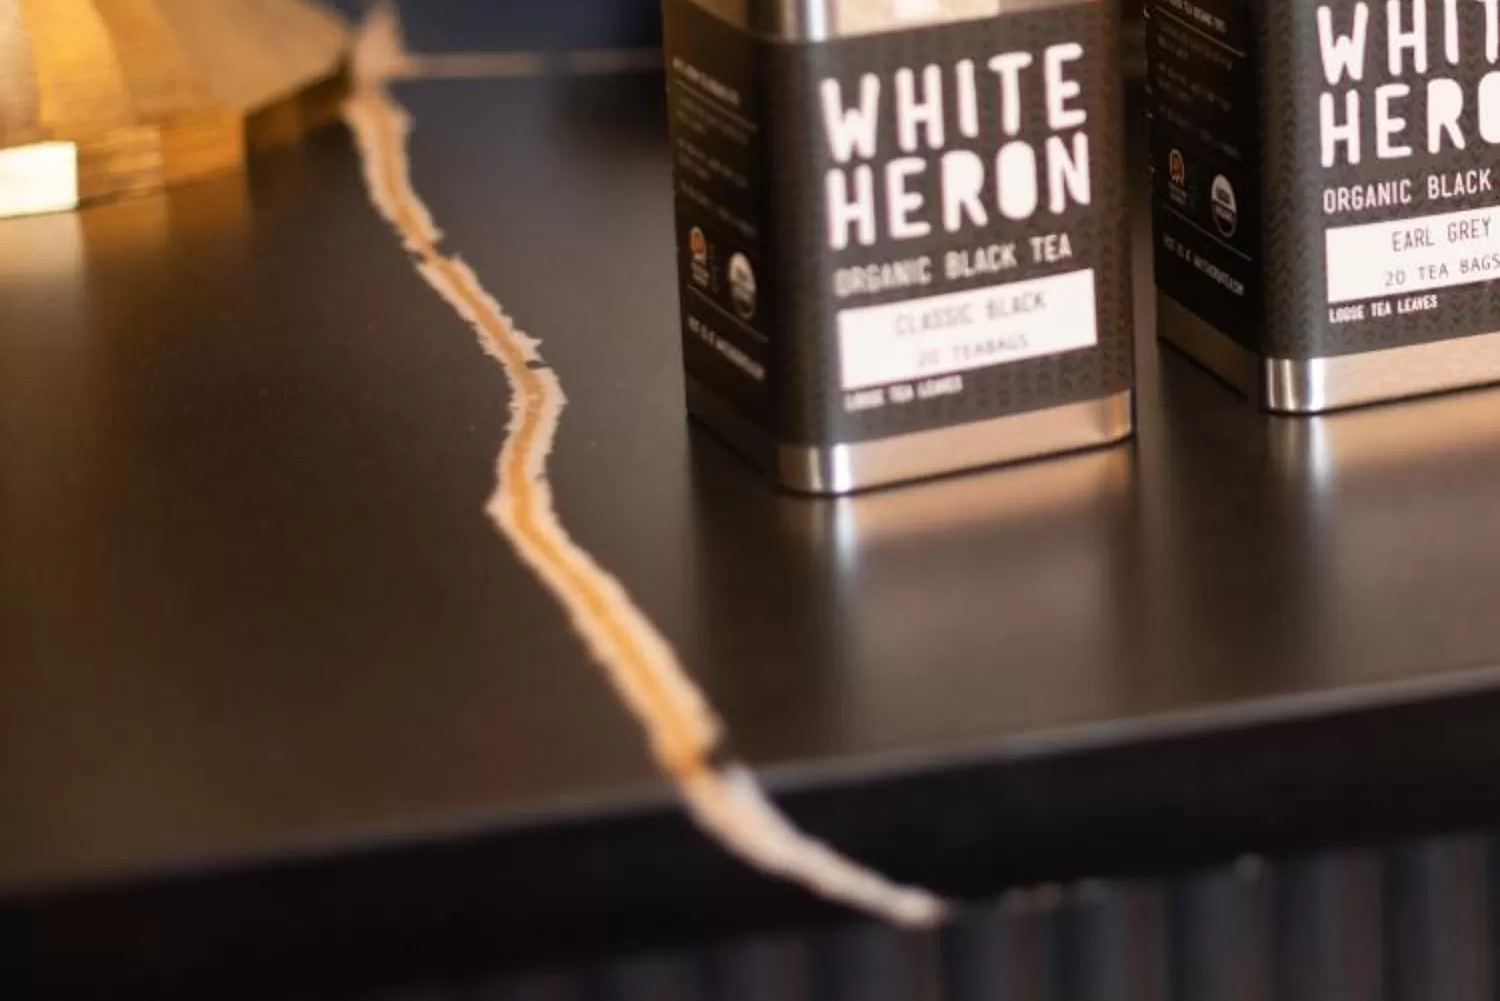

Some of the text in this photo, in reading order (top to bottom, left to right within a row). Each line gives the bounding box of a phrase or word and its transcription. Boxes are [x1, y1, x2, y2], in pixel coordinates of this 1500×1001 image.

[819, 42, 1087, 163] WHITE
[825, 131, 1091, 250] HERON
[1323, 178, 1412, 214] ORGANIC
[1427, 167, 1492, 199] BLACK
[1391, 216, 1493, 252] EARL GREY
[832, 233, 1073, 297] ORGANIC BLACK TEA
[1384, 270, 1406, 288] 20
[1417, 262, 1449, 282] TEA
[895, 291, 1047, 337] CLASSIC BLACK
[1329, 294, 1438, 324] LOOSE TEA LEAVES
